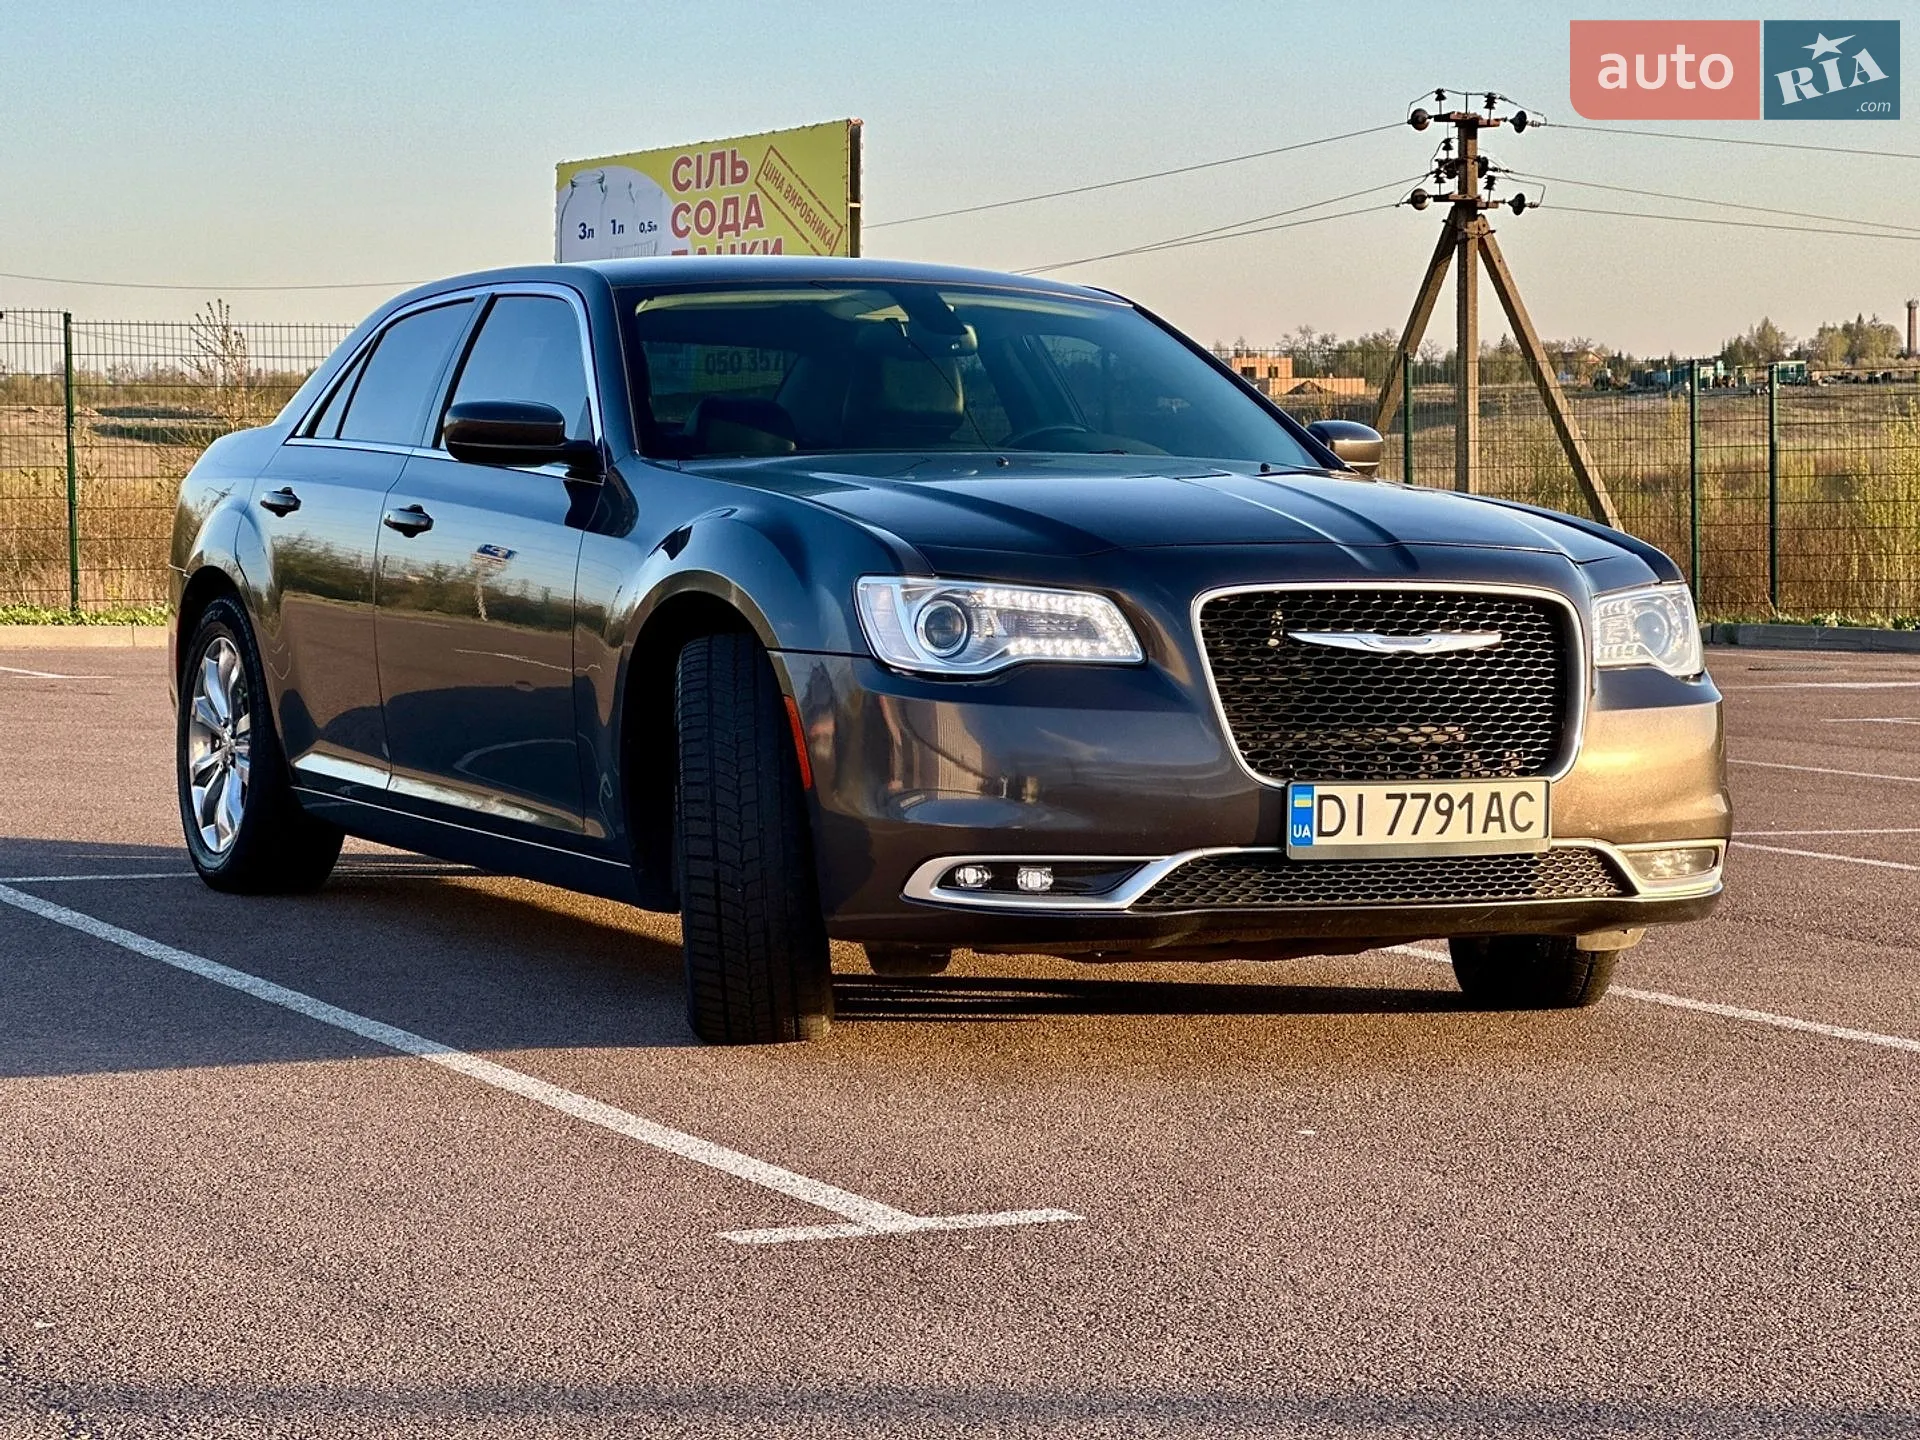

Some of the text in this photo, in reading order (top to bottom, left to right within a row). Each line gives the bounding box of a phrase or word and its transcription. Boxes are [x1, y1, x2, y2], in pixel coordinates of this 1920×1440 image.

[672, 149, 749, 193] СІЛЬ
[610, 219, 625, 235] 1л
[671, 193, 765, 239] СОДА
[762, 160, 835, 250] ЦІНА ВИРОБНИКА
[578, 222, 595, 240] 3л
[1293, 824, 1312, 839] UA
[1316, 793, 1364, 838] DI
